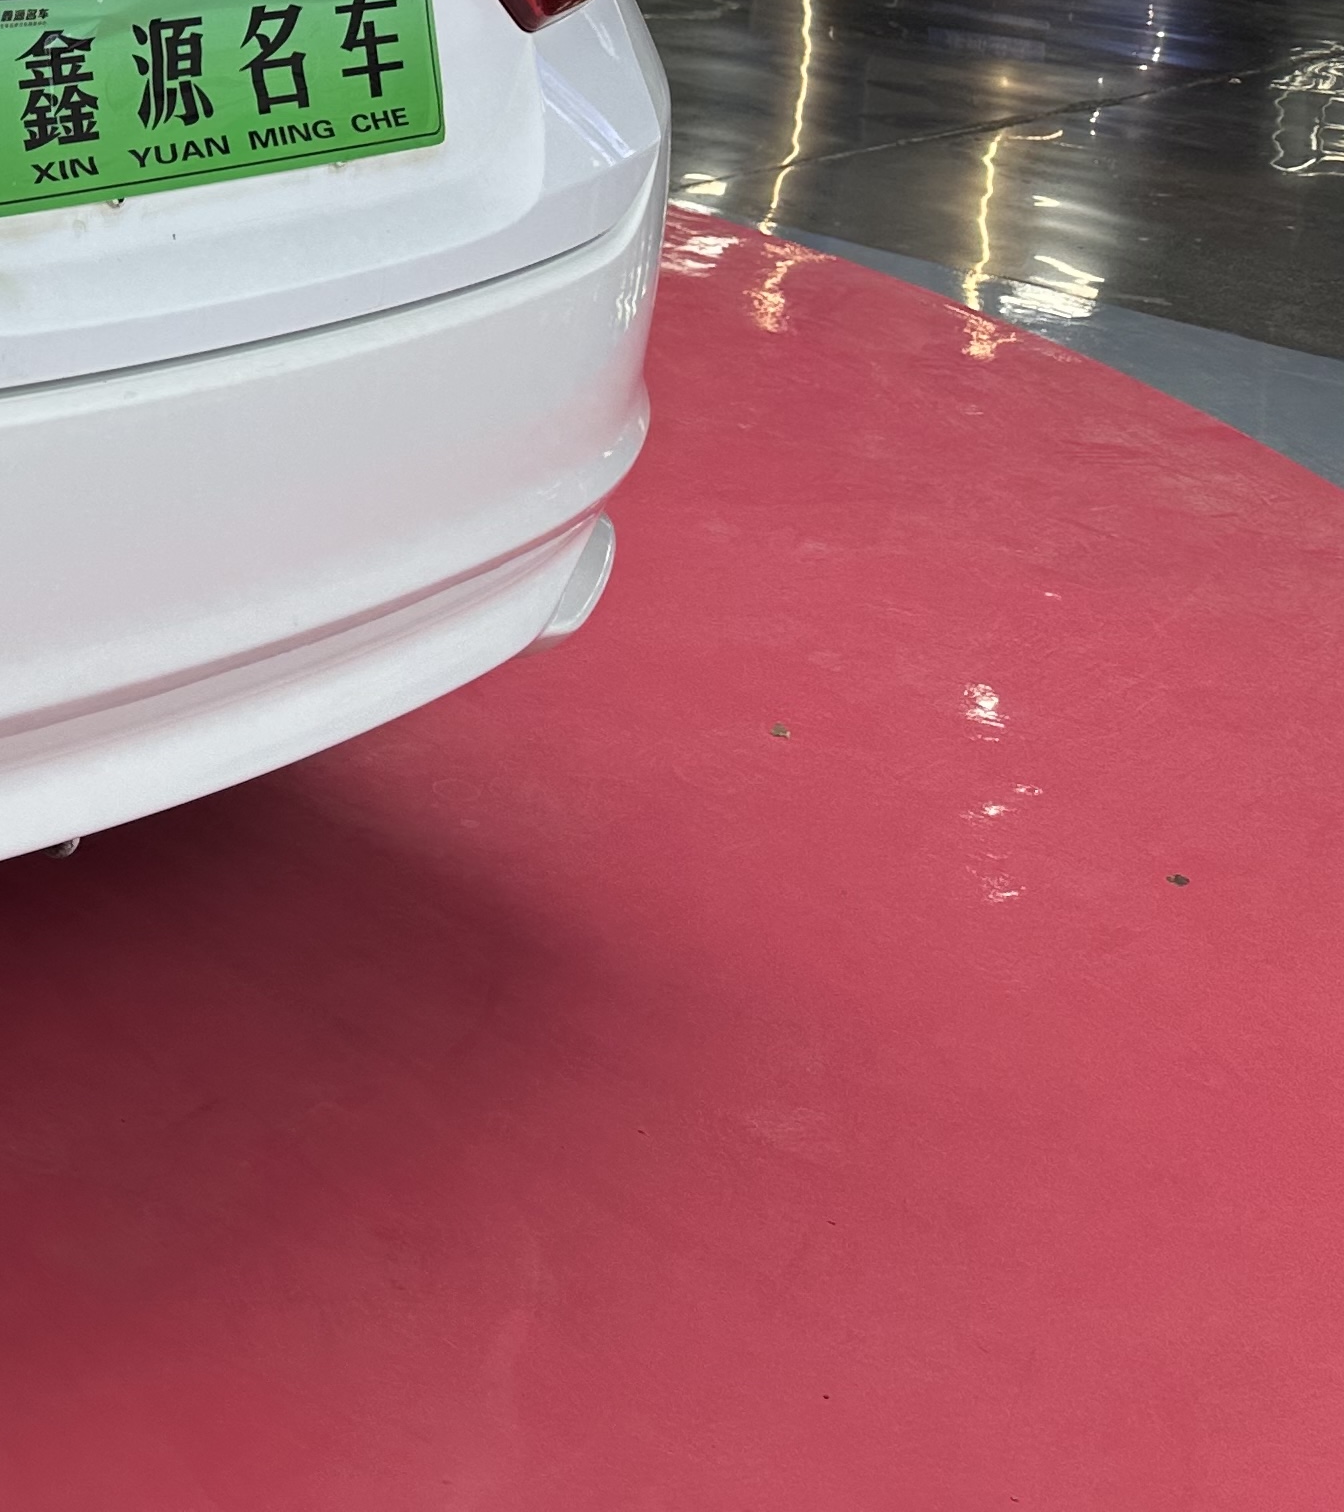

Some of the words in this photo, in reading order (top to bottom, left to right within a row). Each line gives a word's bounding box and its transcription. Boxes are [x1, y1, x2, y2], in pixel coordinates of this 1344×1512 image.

[31, 156, 100, 185] XIN
[126, 135, 231, 169] YUAN
[248, 118, 336, 152] MING
[349, 106, 410, 134] CHE
